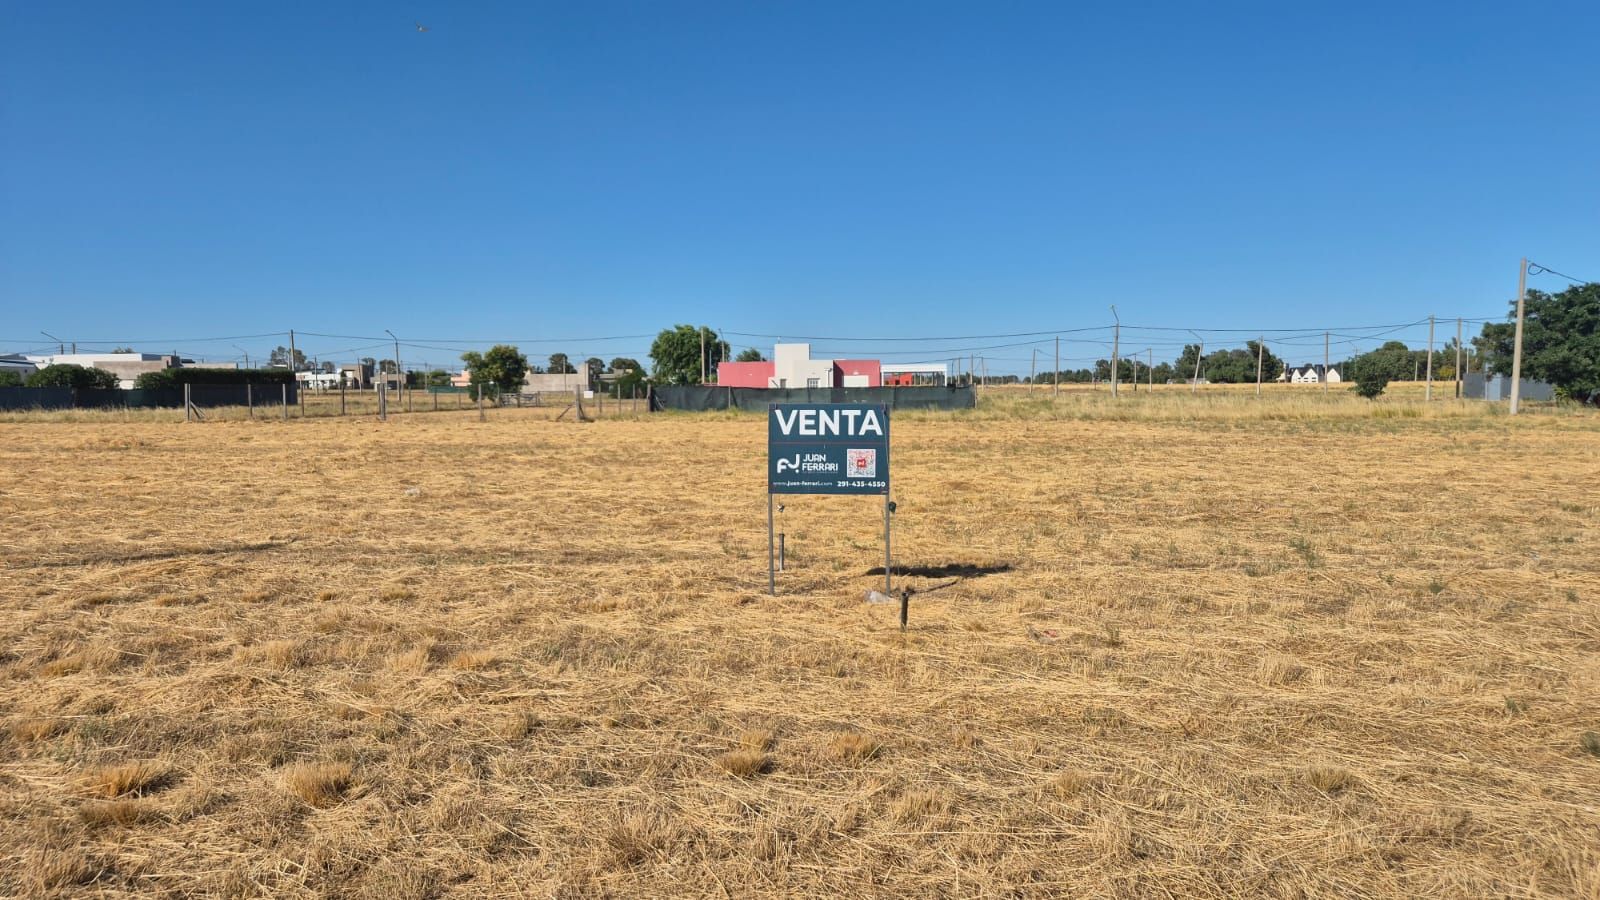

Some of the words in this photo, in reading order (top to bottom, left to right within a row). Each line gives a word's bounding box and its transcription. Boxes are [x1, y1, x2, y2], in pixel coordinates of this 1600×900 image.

[774, 409, 883, 436] VENTA
[803, 454, 826, 462] JUAN
[802, 463, 838, 471] FERRARI
